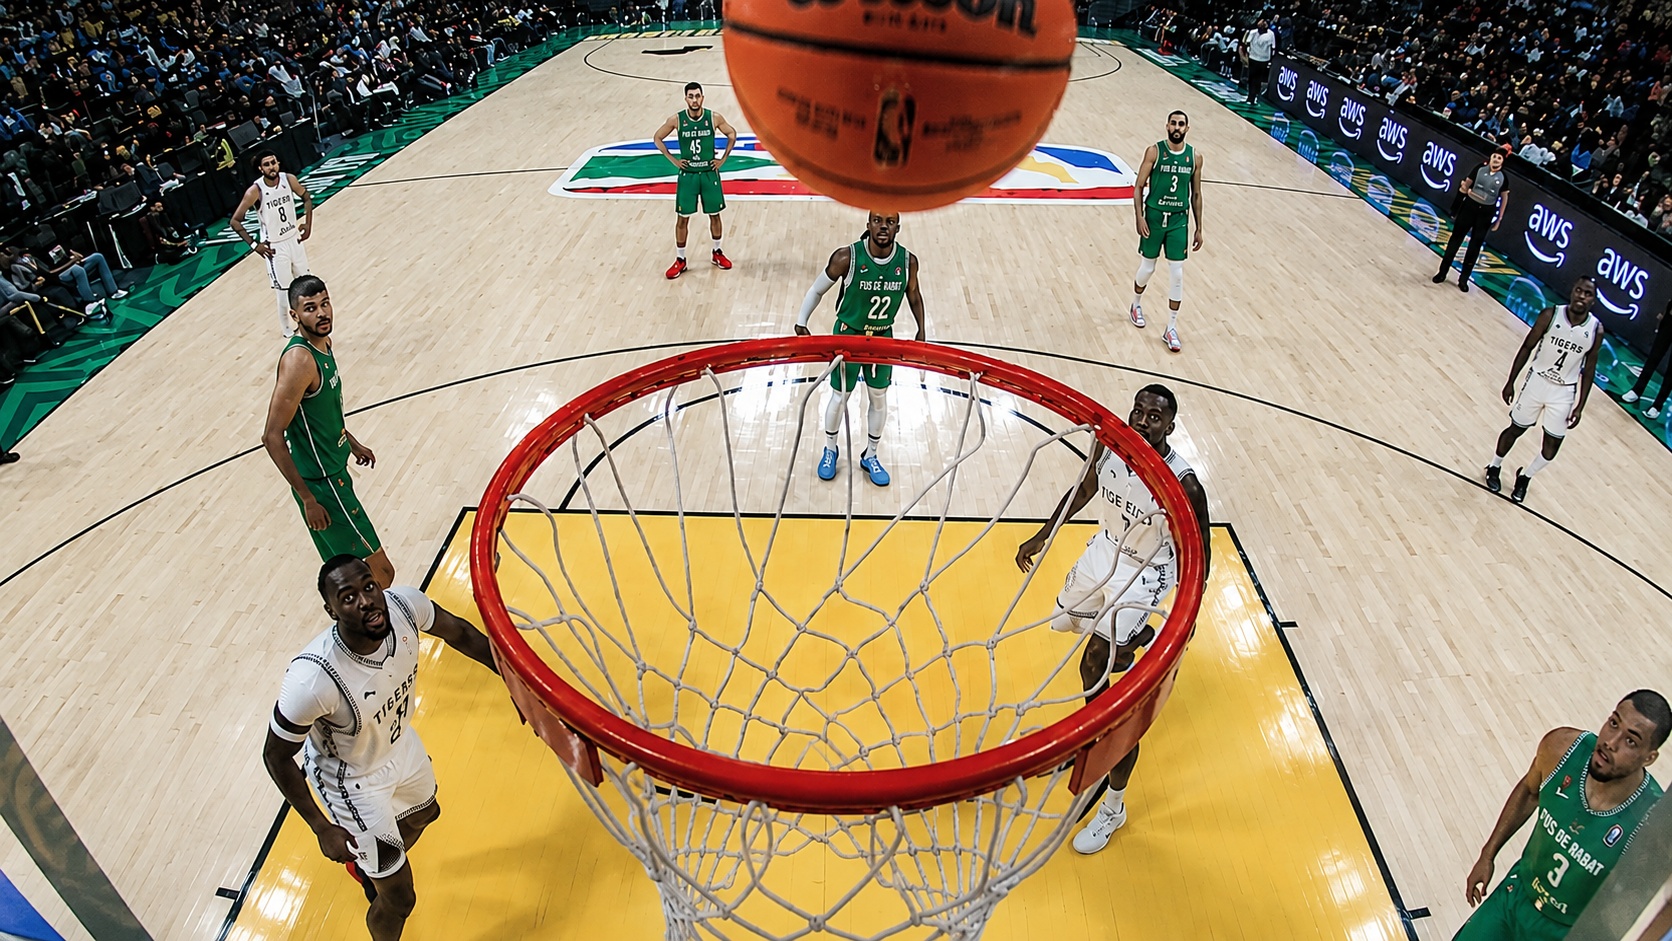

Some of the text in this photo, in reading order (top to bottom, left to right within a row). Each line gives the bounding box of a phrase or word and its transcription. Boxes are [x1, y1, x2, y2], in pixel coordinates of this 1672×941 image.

[1278, 66, 1298, 91] aws
[1306, 80, 1329, 107] aws
[1340, 97, 1366, 126] aws
[1378, 116, 1408, 149] aws
[690, 139, 702, 154] 45
[1422, 141, 1457, 177] aws
[1170, 175, 1179, 193] 3
[278, 206, 287, 223] 8
[1528, 203, 1573, 249] aws
[859, 280, 873, 291] FUS
[1596, 247, 1649, 300] aws
[867, 295, 891, 319] 22
[1550, 335, 1584, 354] TIGERS
[1554, 351, 1568, 371] 4
[1554, 828, 1572, 849] DE
[1567, 842, 1605, 876] RABAT
[1547, 852, 1570, 888] 3
